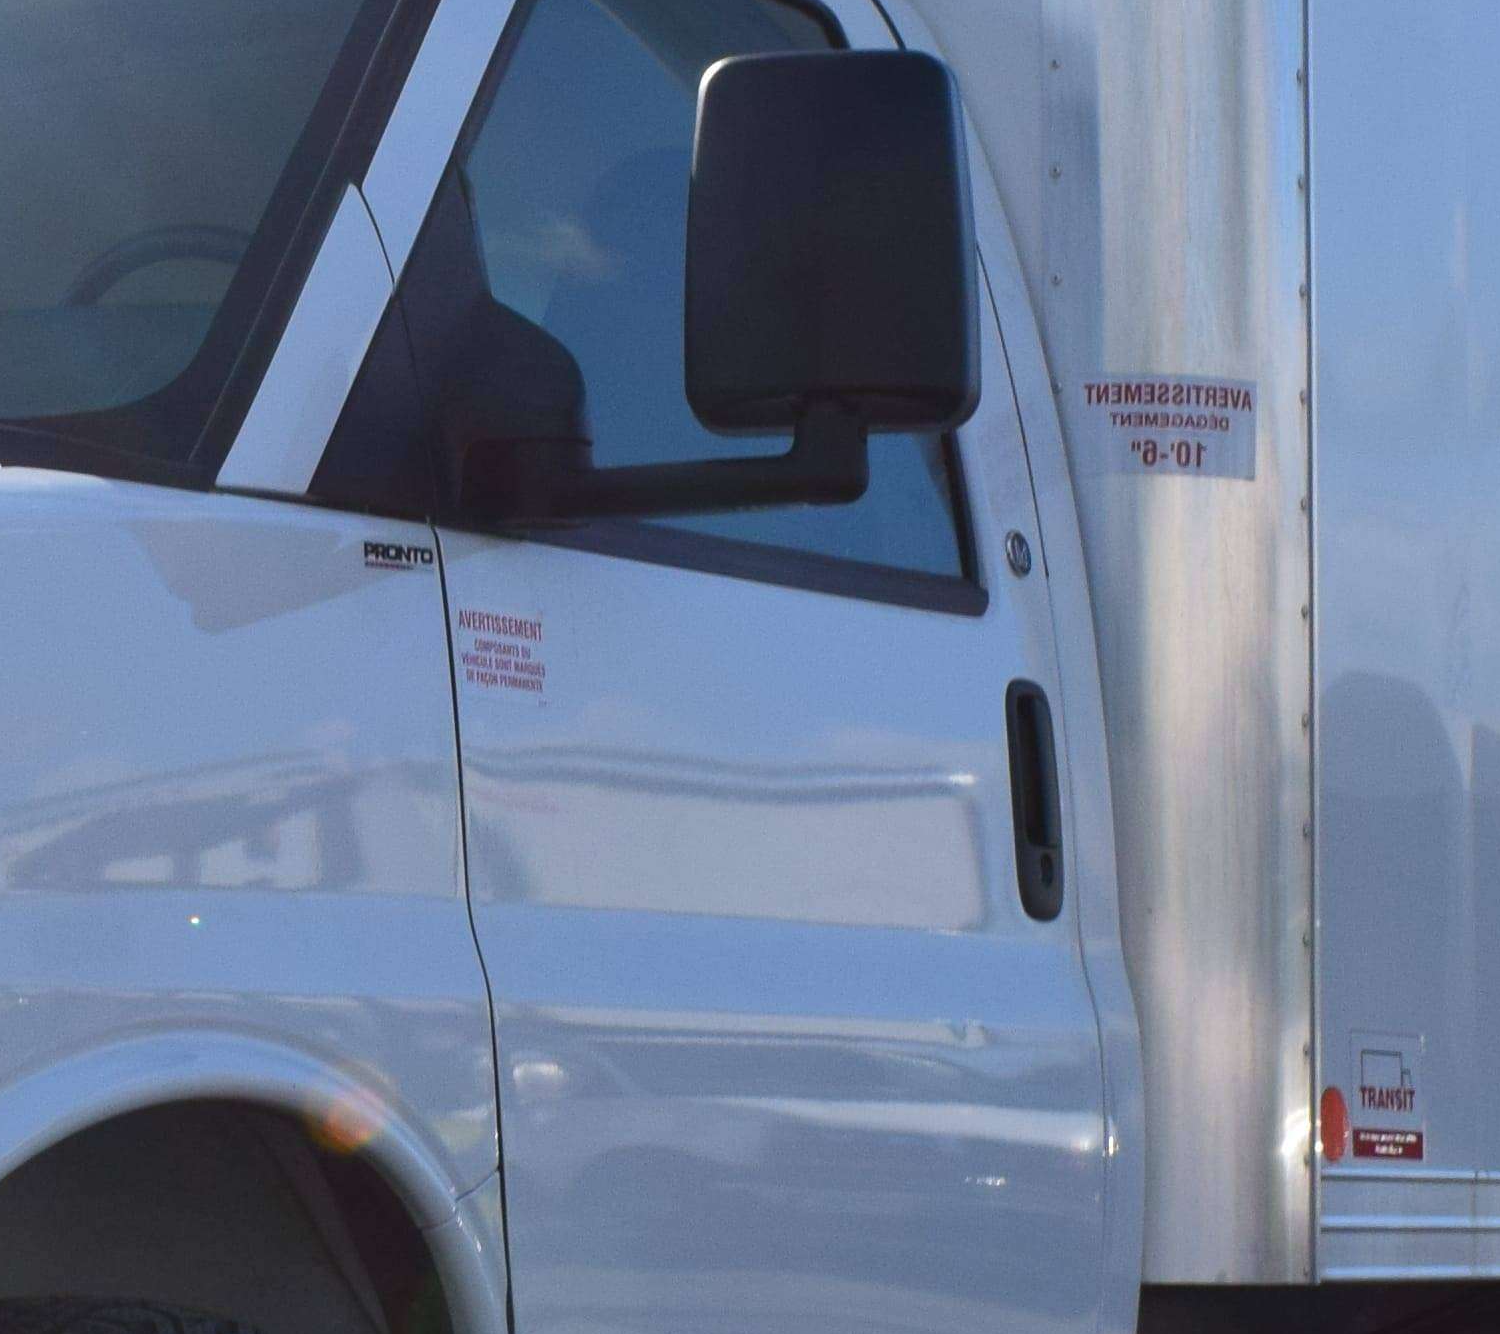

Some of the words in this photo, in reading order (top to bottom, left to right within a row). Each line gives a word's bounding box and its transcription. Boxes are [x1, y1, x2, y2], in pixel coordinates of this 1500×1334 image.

[363, 541, 434, 565] PRONTO
[458, 610, 543, 642] AVERTISSEMENT
[1359, 1085, 1416, 1112] TRANSIT
